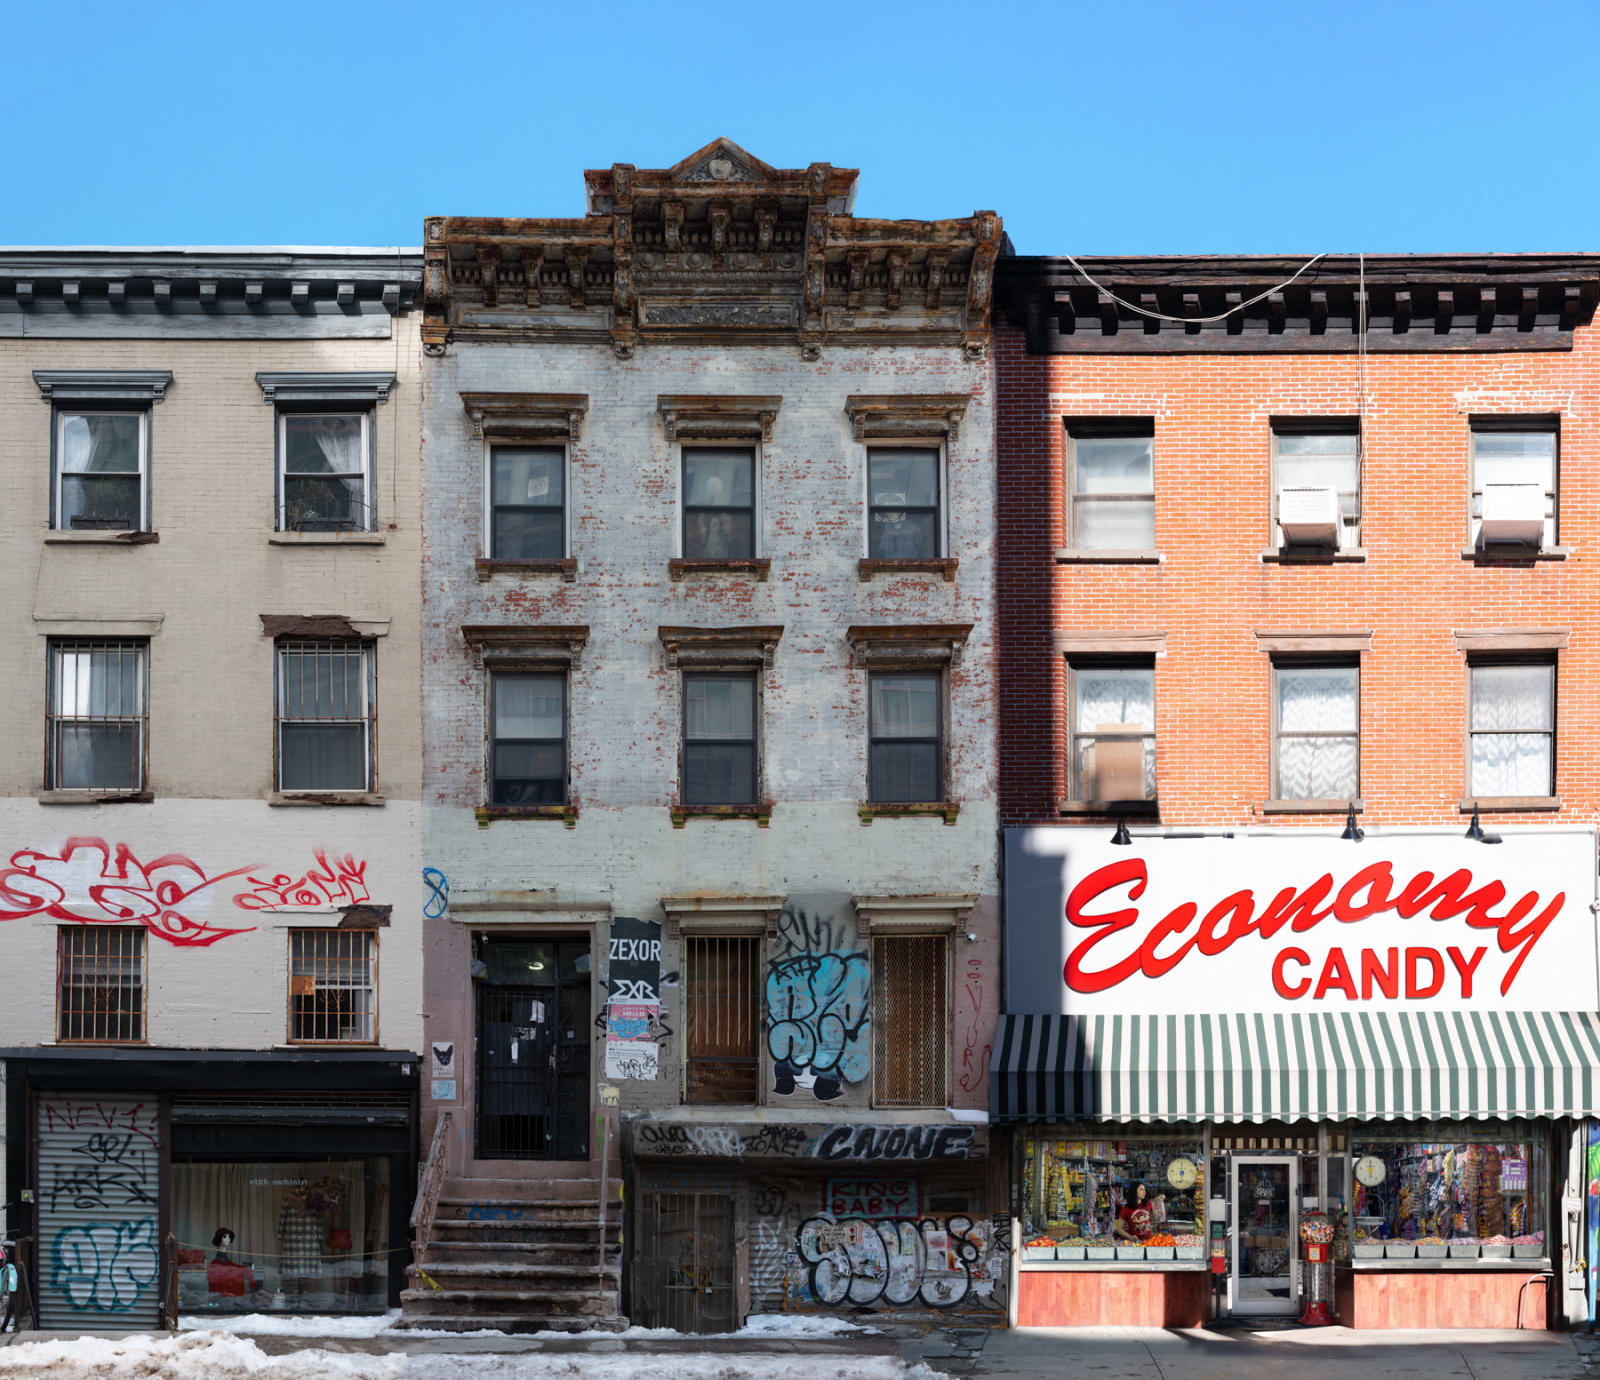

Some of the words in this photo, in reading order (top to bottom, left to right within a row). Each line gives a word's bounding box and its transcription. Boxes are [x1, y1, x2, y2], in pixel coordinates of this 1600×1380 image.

[1063, 858, 1566, 993] Economy
[609, 938, 661, 961] ZEXOR
[1271, 946, 1489, 1000] CANDY
[832, 1182, 910, 1198] KING
[831, 1199, 910, 1216] BABY
